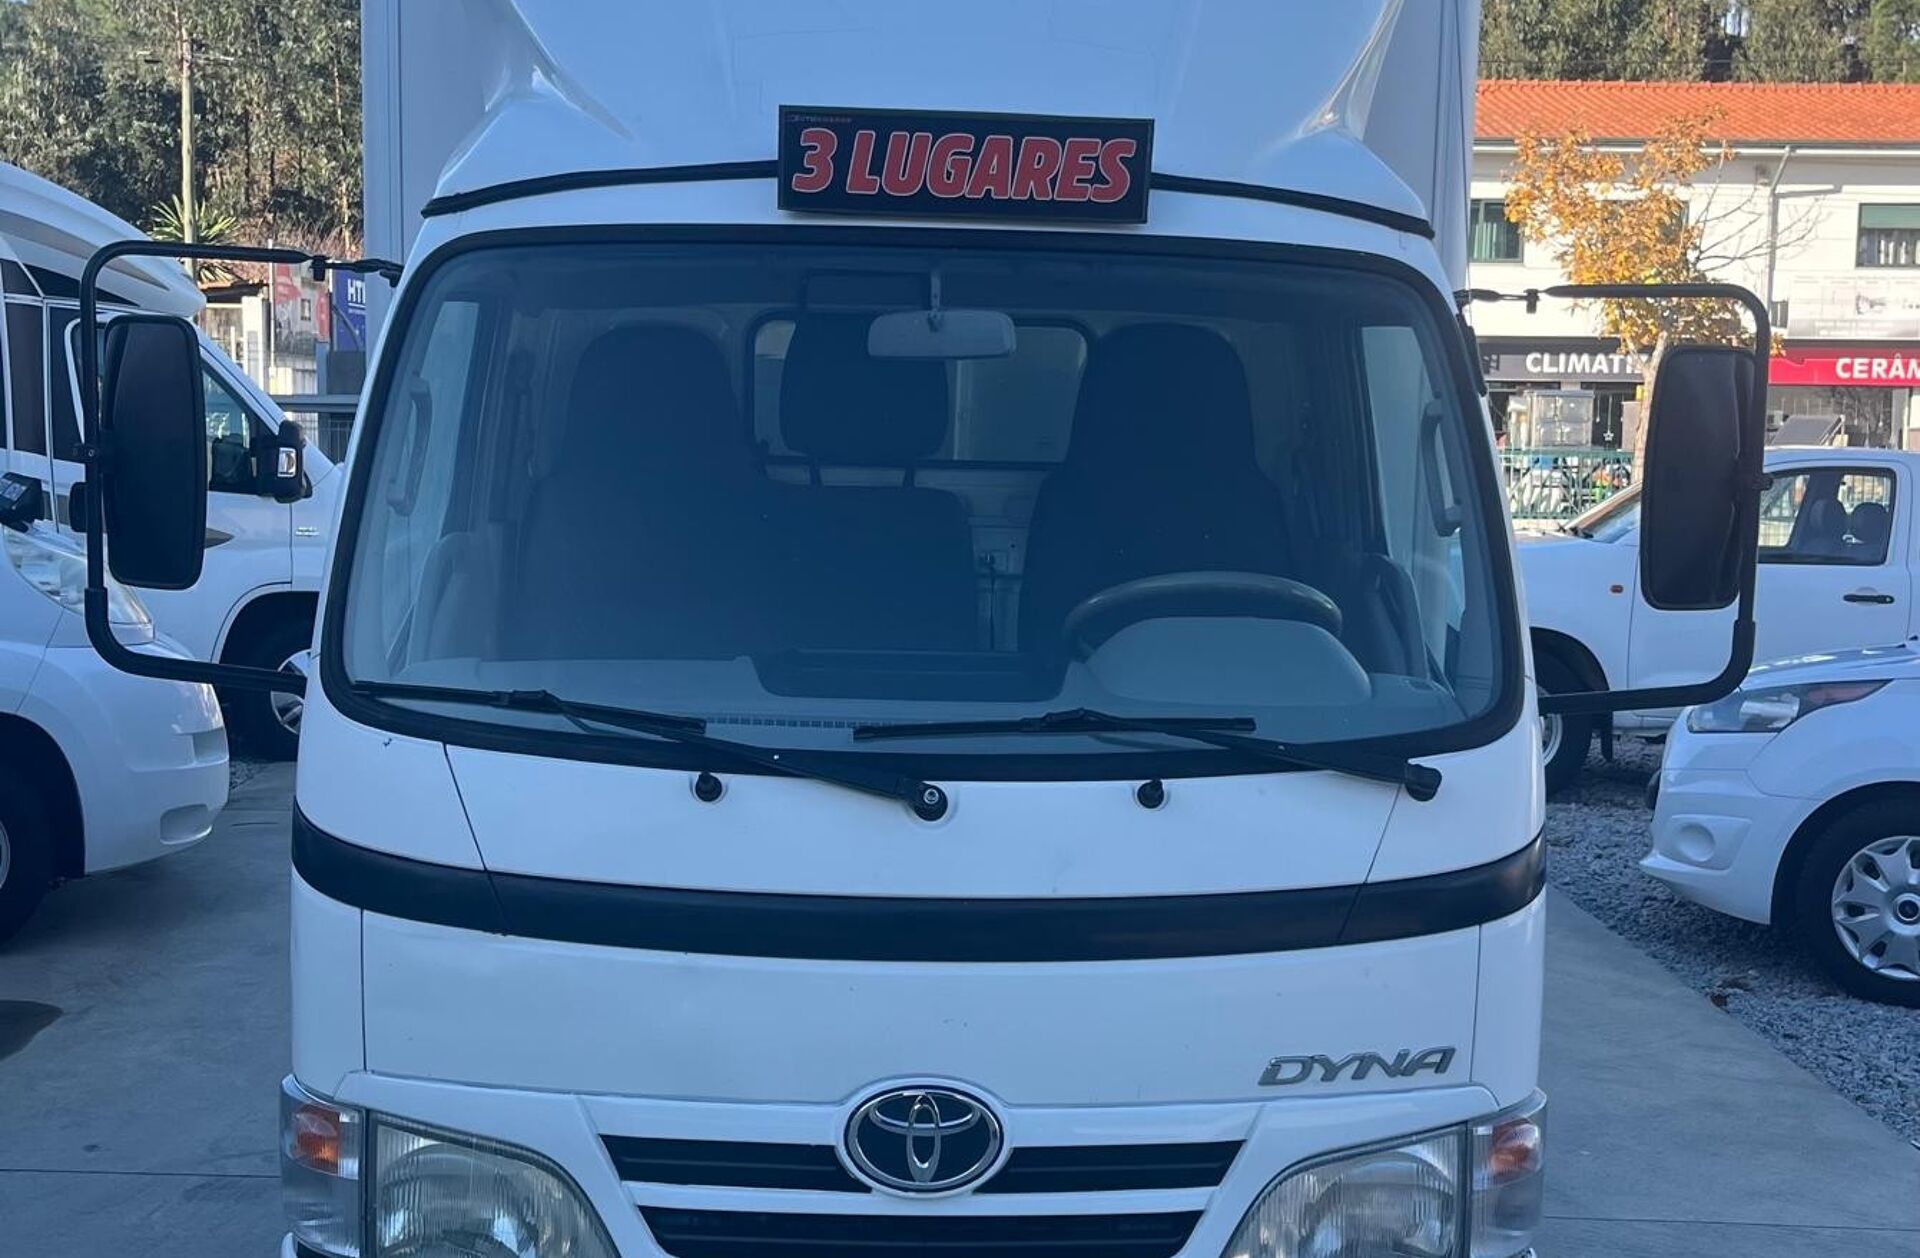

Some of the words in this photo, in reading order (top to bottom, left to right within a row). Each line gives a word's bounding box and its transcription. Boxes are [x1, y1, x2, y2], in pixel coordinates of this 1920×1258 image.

[792, 127, 838, 193] 3
[846, 130, 1136, 203] LUGARES
[1258, 1046, 1456, 1086] DYNA
